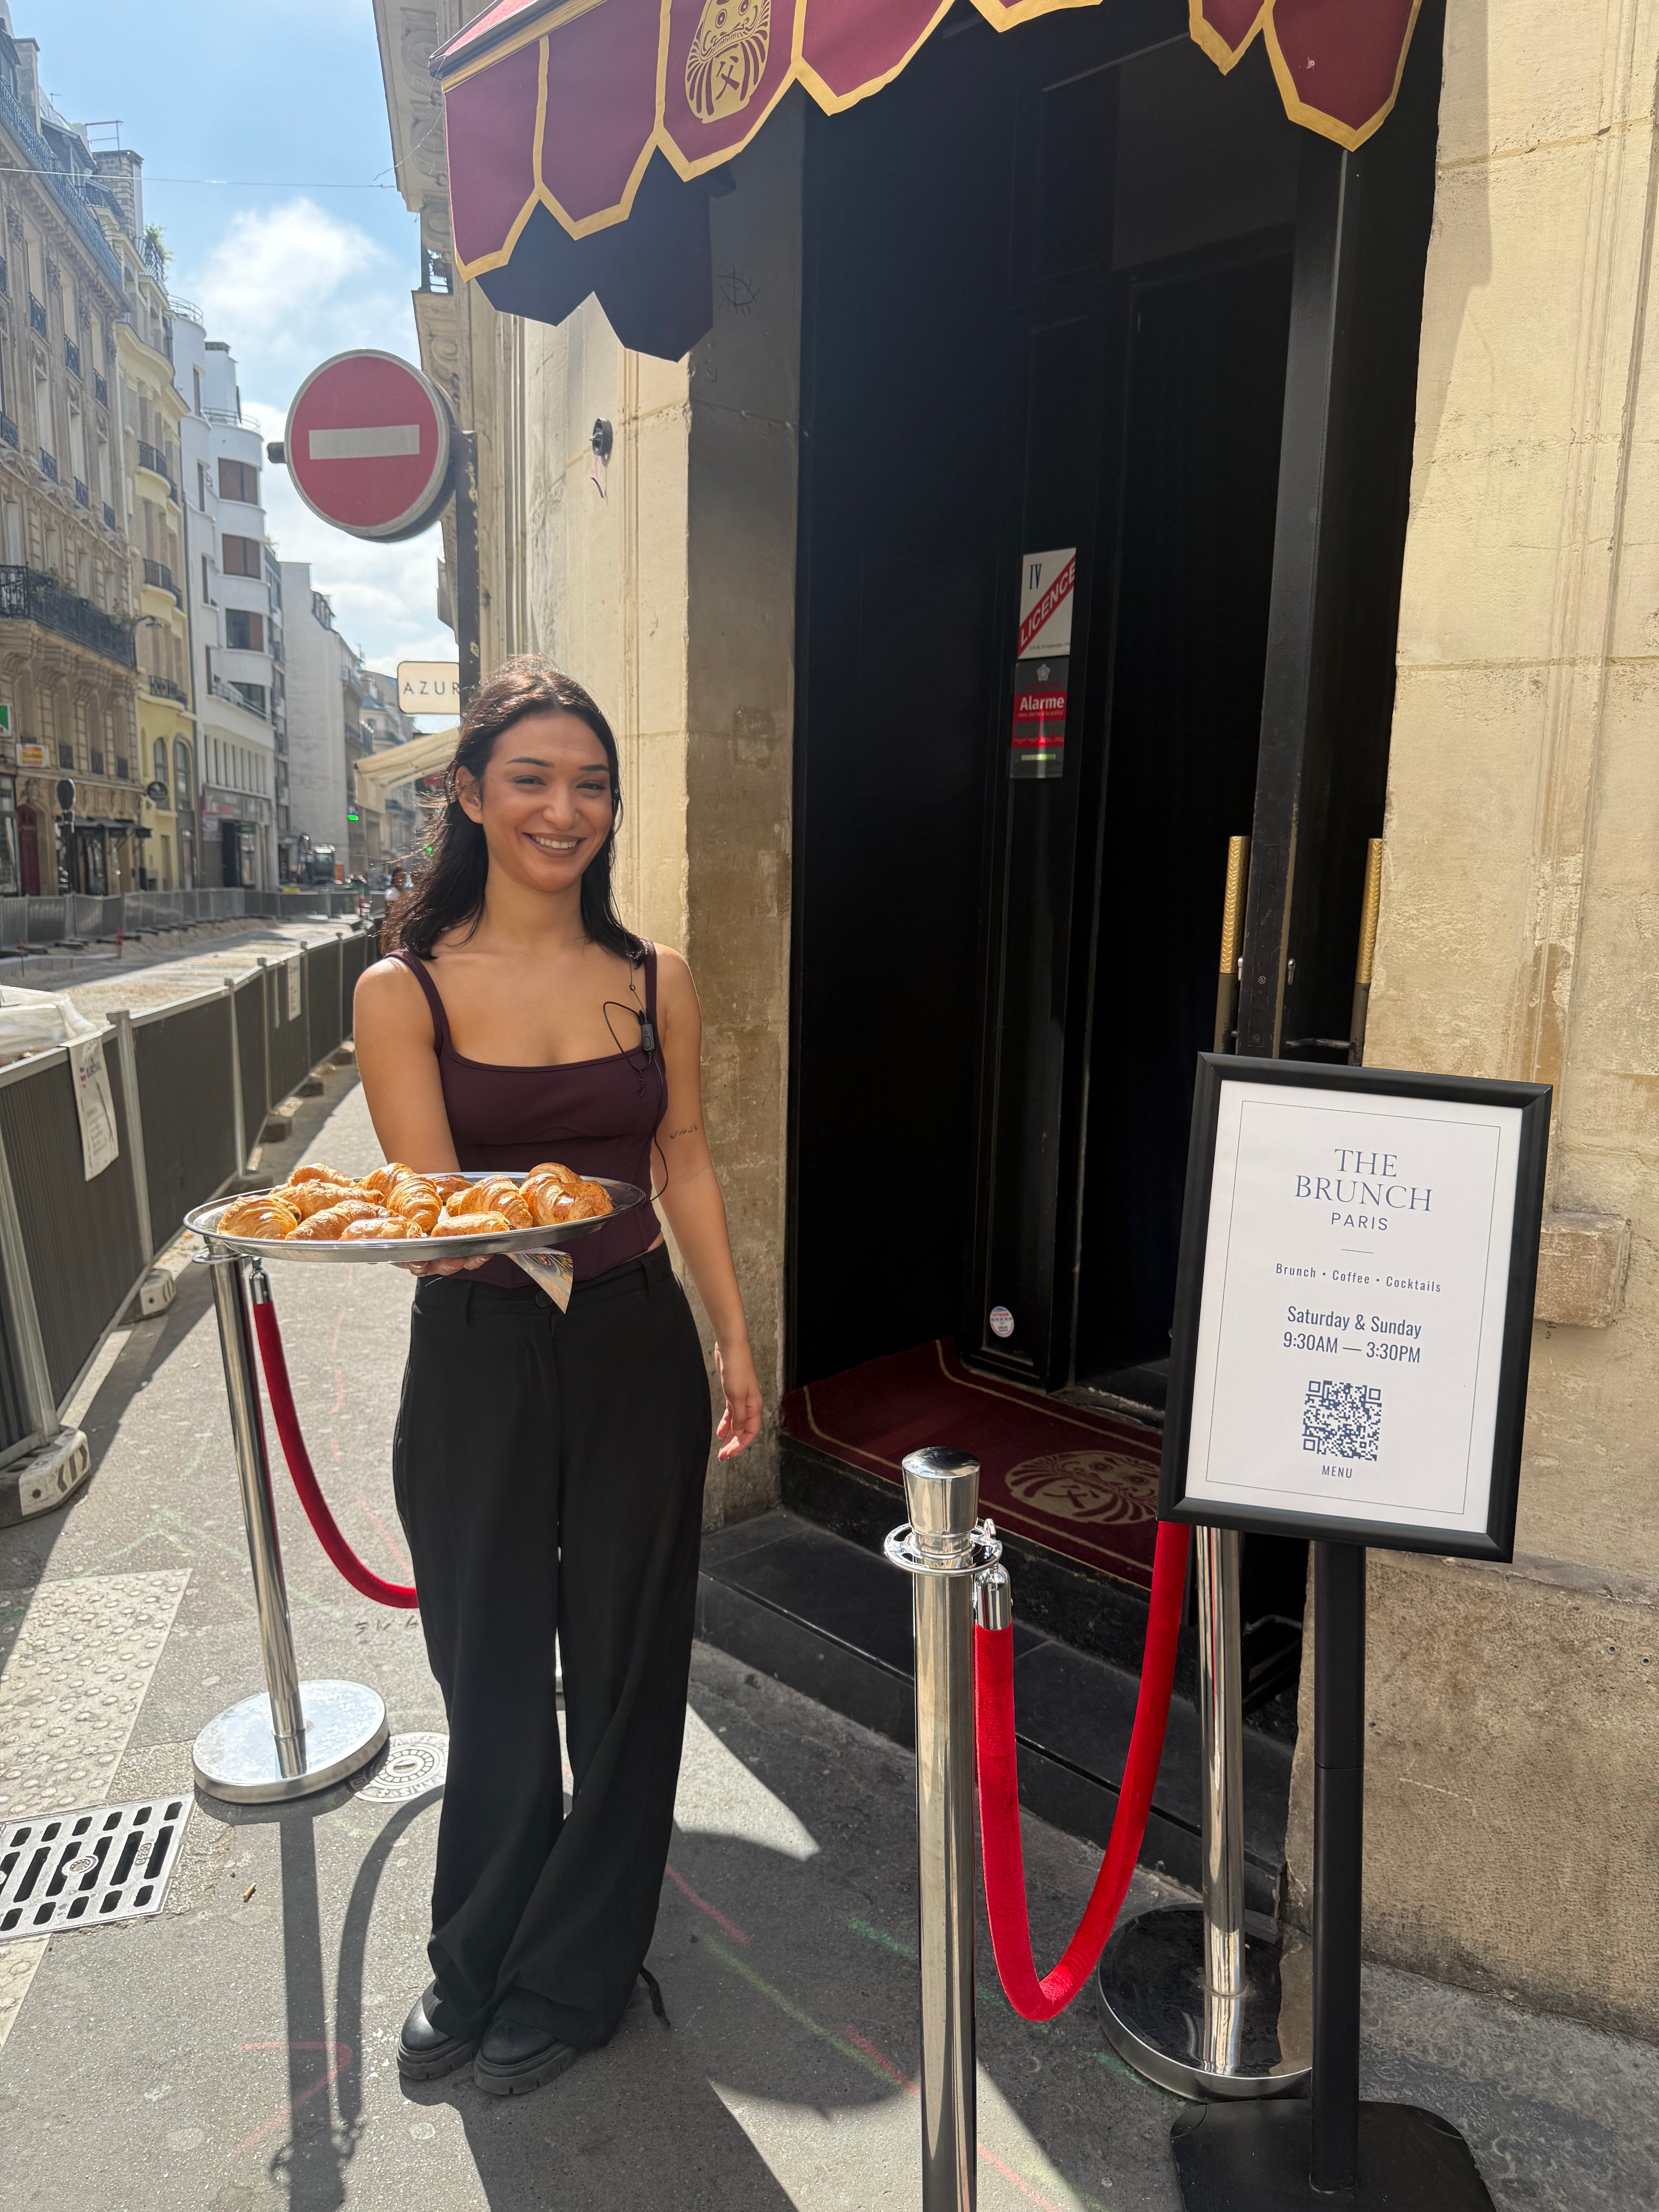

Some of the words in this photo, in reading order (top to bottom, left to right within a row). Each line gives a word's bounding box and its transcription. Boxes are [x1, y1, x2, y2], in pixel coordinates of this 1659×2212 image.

[716, 56, 740, 100] 父
[1029, 564, 1042, 590] IV
[1021, 562, 1075, 647] LICENCE
[403, 681, 460, 696] AZUR
[1020, 695, 1064, 711] Alarme
[1334, 1149, 1397, 1177] THE
[1293, 1175, 1433, 1211] BRUNCH
[1331, 1212, 1388, 1230] PARIS
[1276, 1263, 1316, 1278] Brunch
[1333, 1270, 1370, 1284] Coffee
[1386, 1276, 1441, 1292] Cocktails
[1287, 1306, 1350, 1331] Saturday
[1355, 1314, 1365, 1331] &
[1371, 1316, 1422, 1339] Sunday
[1283, 1331, 1338, 1353] 9:30AM
[1366, 1341, 1420, 1363] 3:30PM
[1322, 1465, 1352, 1478] MENU
